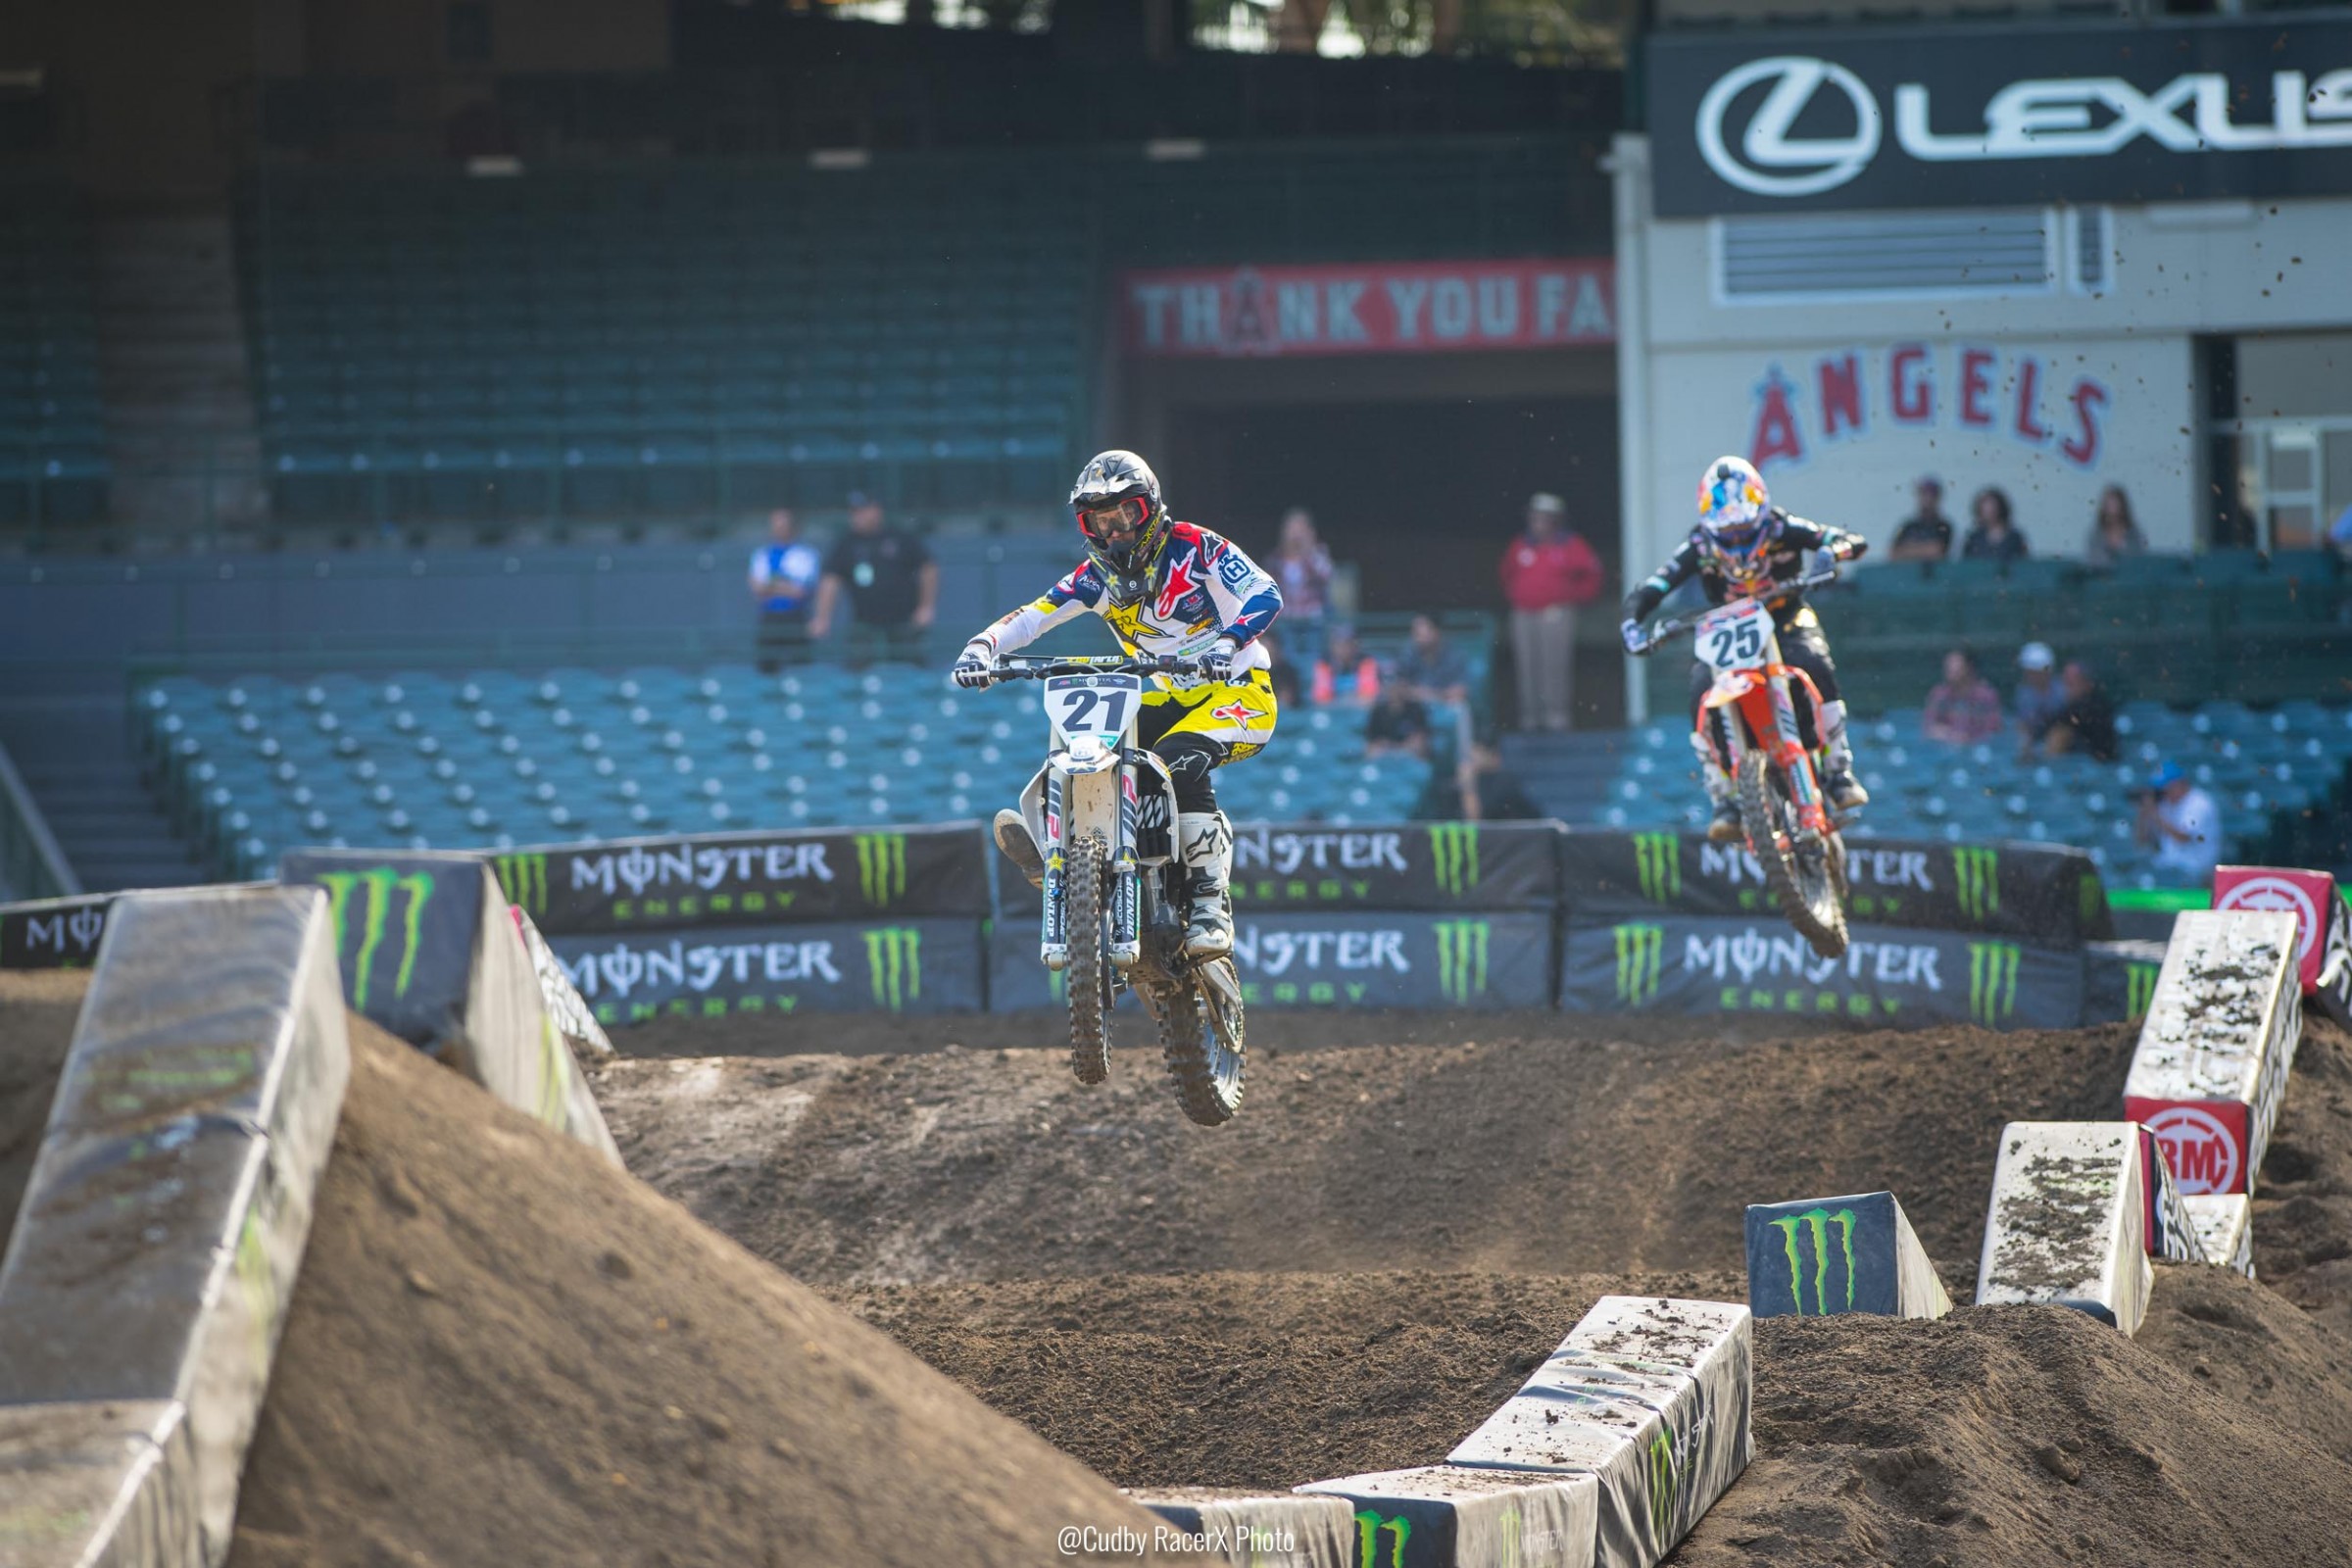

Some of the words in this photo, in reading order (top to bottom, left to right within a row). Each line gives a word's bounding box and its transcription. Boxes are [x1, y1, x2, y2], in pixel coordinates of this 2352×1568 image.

[1132, 265, 1369, 355] THANK
[1385, 274, 1518, 342] YOU
[1749, 343, 2110, 470] ANGELS
[1711, 618, 1760, 667] 25
[1061, 689, 1128, 732] 21
[571, 843, 834, 896] MONSTER
[1233, 824, 1409, 874] NSTER
[1126, 876, 1135, 938] DUNLOP
[1229, 880, 1371, 901] NERGY
[556, 940, 843, 999] MONSTER
[1235, 924, 1411, 977] NSTER
[1242, 982, 1367, 1004] ERGY
